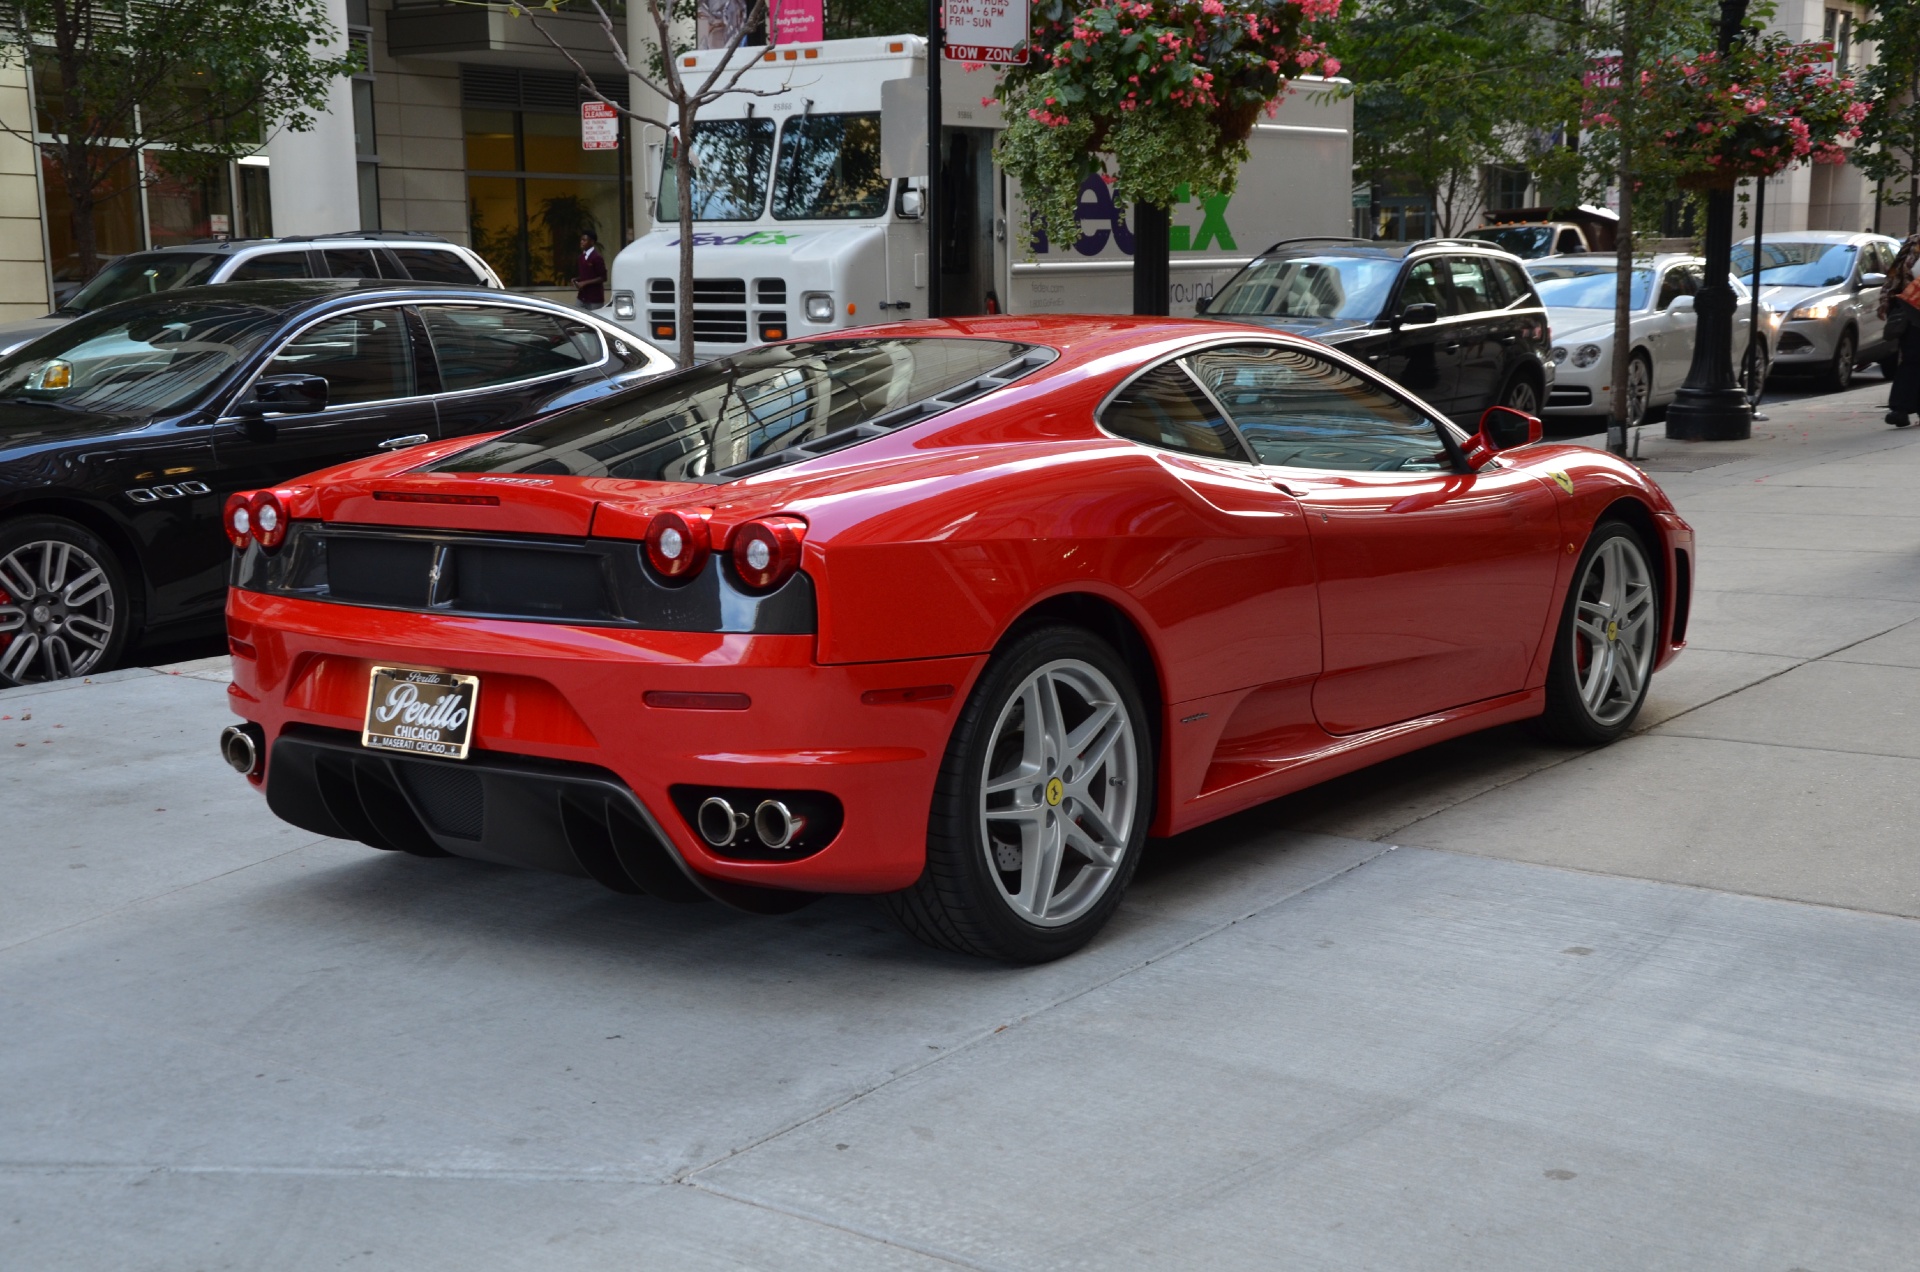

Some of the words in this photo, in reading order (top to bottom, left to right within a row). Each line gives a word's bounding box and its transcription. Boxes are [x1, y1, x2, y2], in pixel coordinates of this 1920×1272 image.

[949, 4, 958, 15] 10
[960, 5, 974, 15] AM
[983, 7, 989, 17] 6
[991, 7, 1004, 17] PM
[949, 16, 964, 26] FRI
[972, 17, 992, 28] SUN
[949, 46, 978, 59] TOW
[584, 110, 613, 118] CLEANING
[665, 230, 803, 246] FedEx
[405, 671, 440, 684] Perillo
[375, 683, 468, 731] Perillo
[394, 725, 440, 741] CHICAGO
[382, 737, 415, 749] MASERATI
[415, 741, 446, 754] CHICAGO
